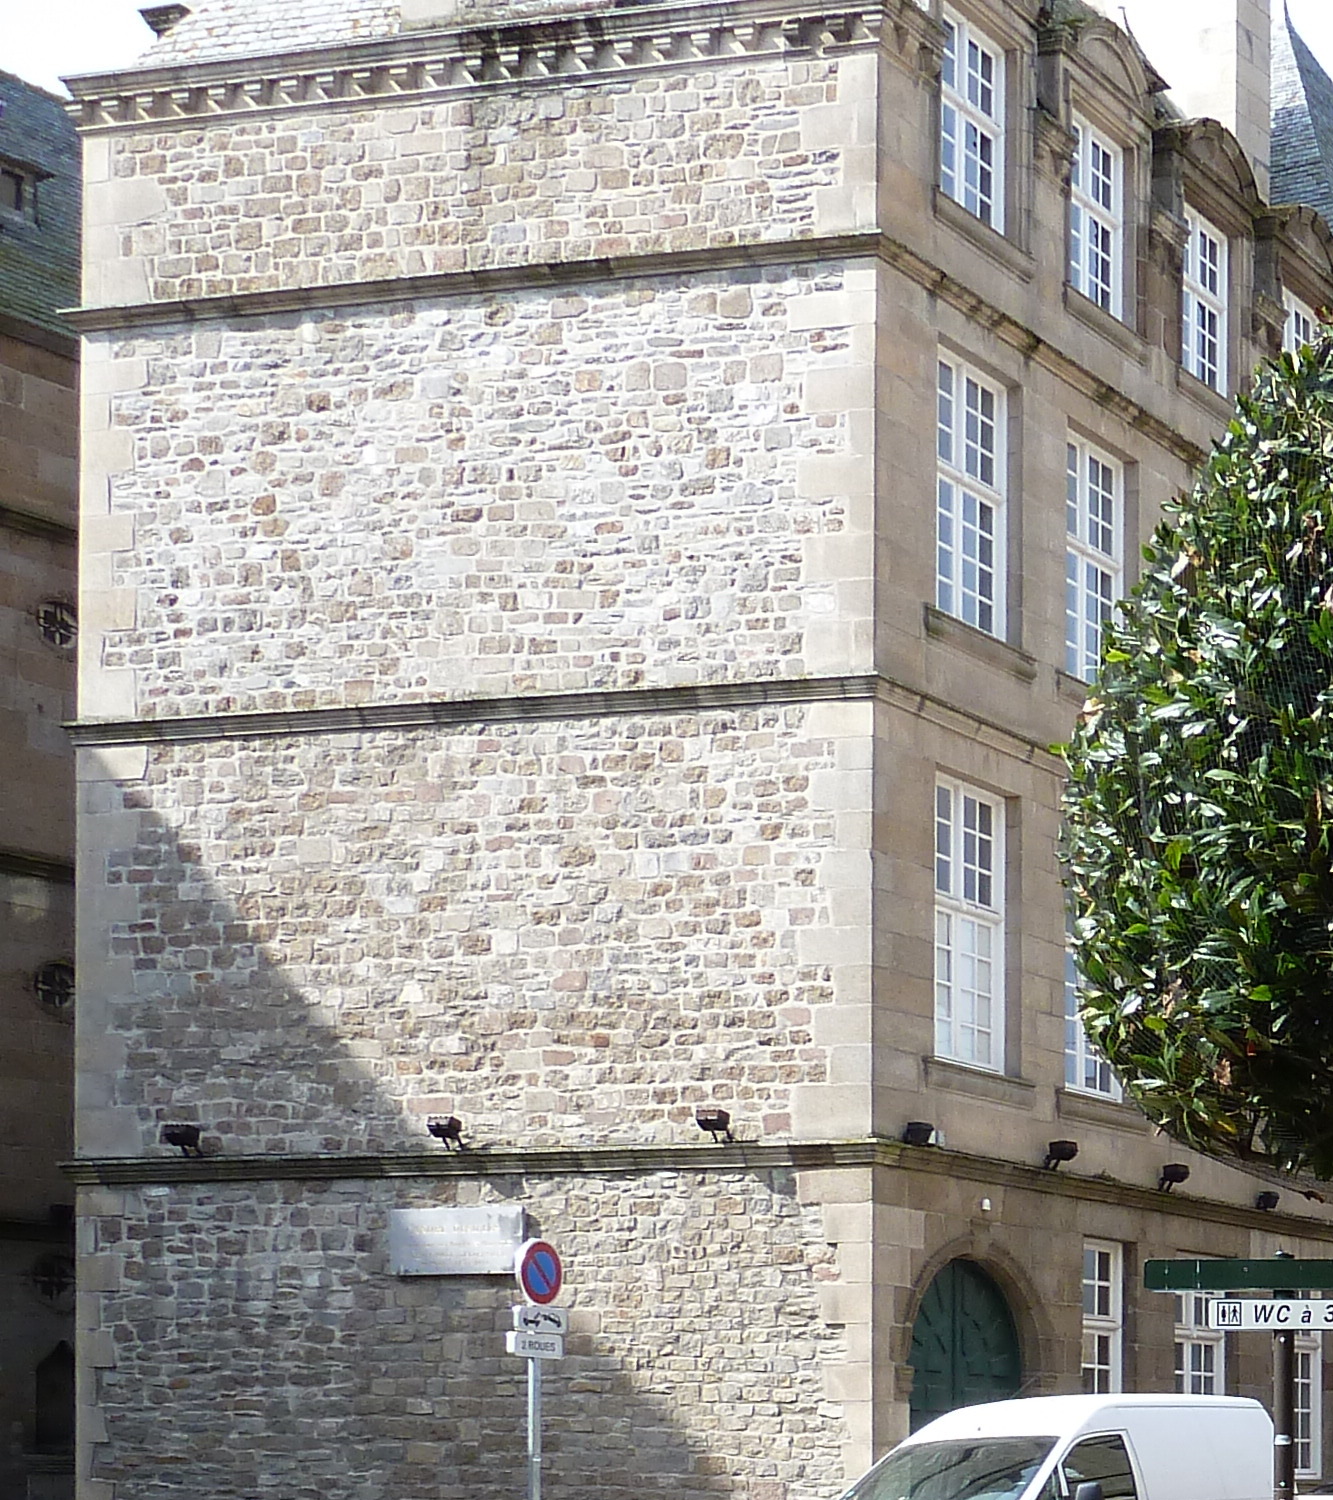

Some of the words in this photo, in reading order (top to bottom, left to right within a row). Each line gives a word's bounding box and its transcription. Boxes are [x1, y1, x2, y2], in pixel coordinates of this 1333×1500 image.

[1253, 1304, 1291, 1323] WC
[1301, 1304, 1312, 1323] à
[521, 1340, 528, 1350] 2
[529, 1340, 556, 1351] ROUES
